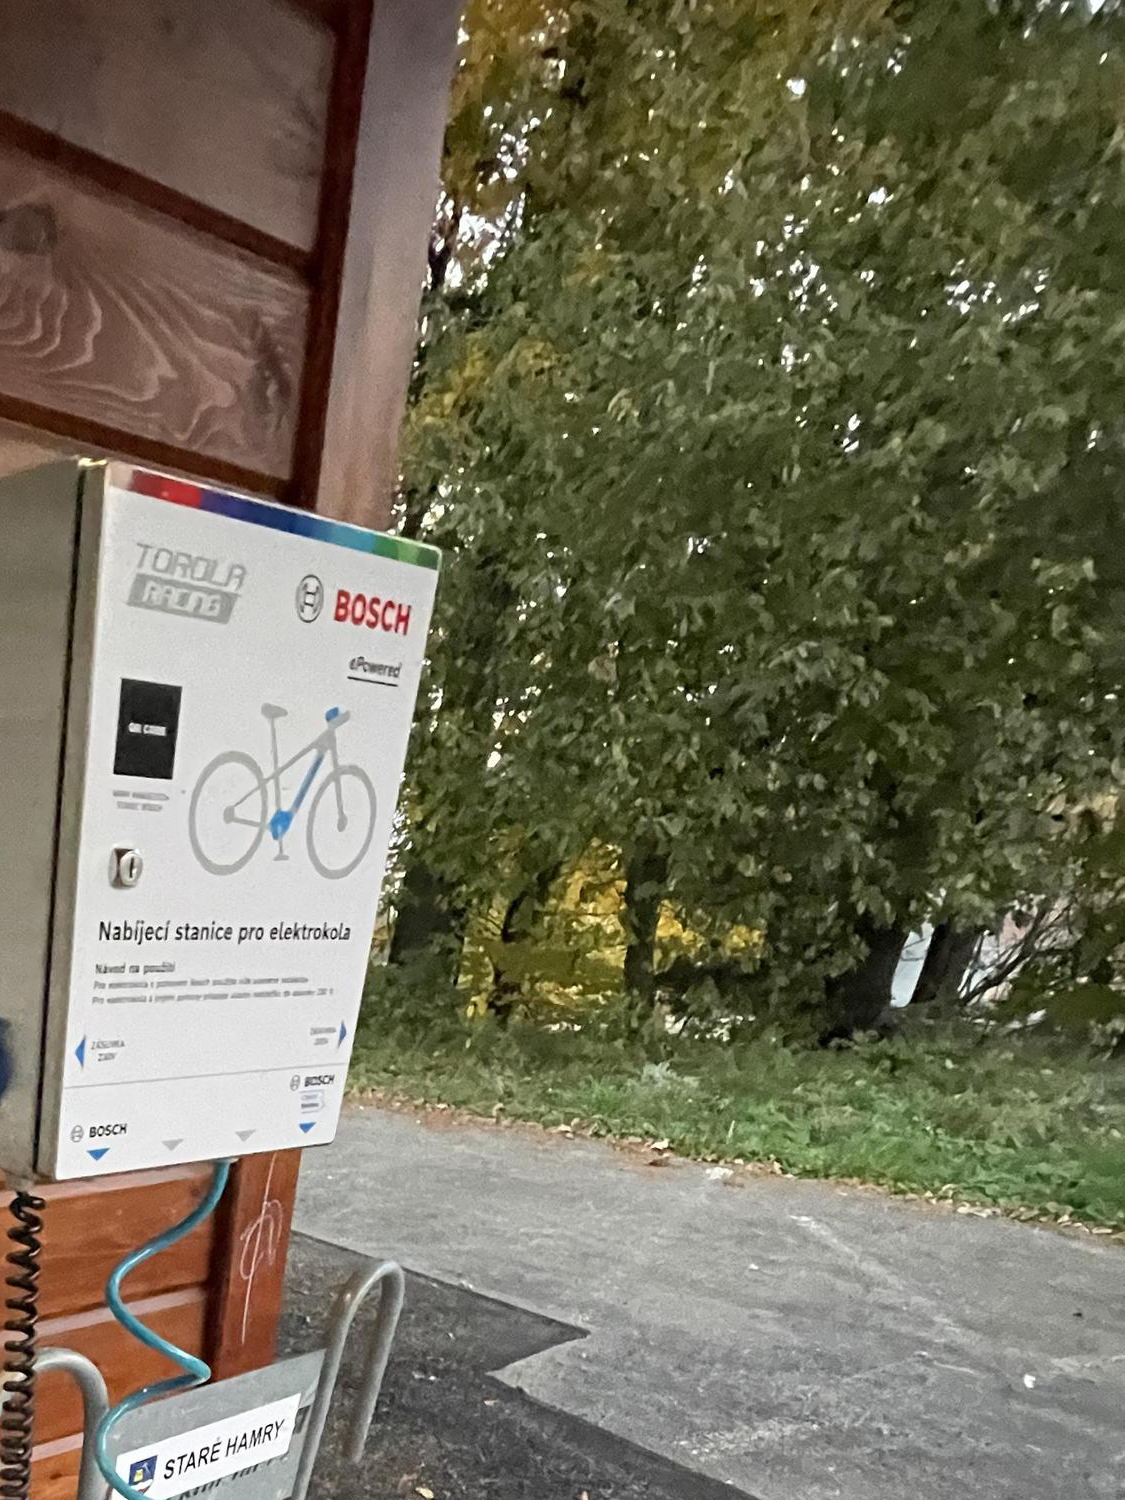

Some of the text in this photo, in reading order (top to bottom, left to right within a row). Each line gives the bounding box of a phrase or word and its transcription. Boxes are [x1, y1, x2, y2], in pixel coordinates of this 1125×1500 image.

[137, 542, 247, 591] TOROLA
[334, 589, 412, 636] BOSCH
[98, 920, 352, 947] Nabíjecí stanice pro elektrokola
[304, 1074, 335, 1087] BOSCH
[89, 1123, 127, 1138] BOSCH
[163, 1419, 285, 1480] STARÉ HAMRY
